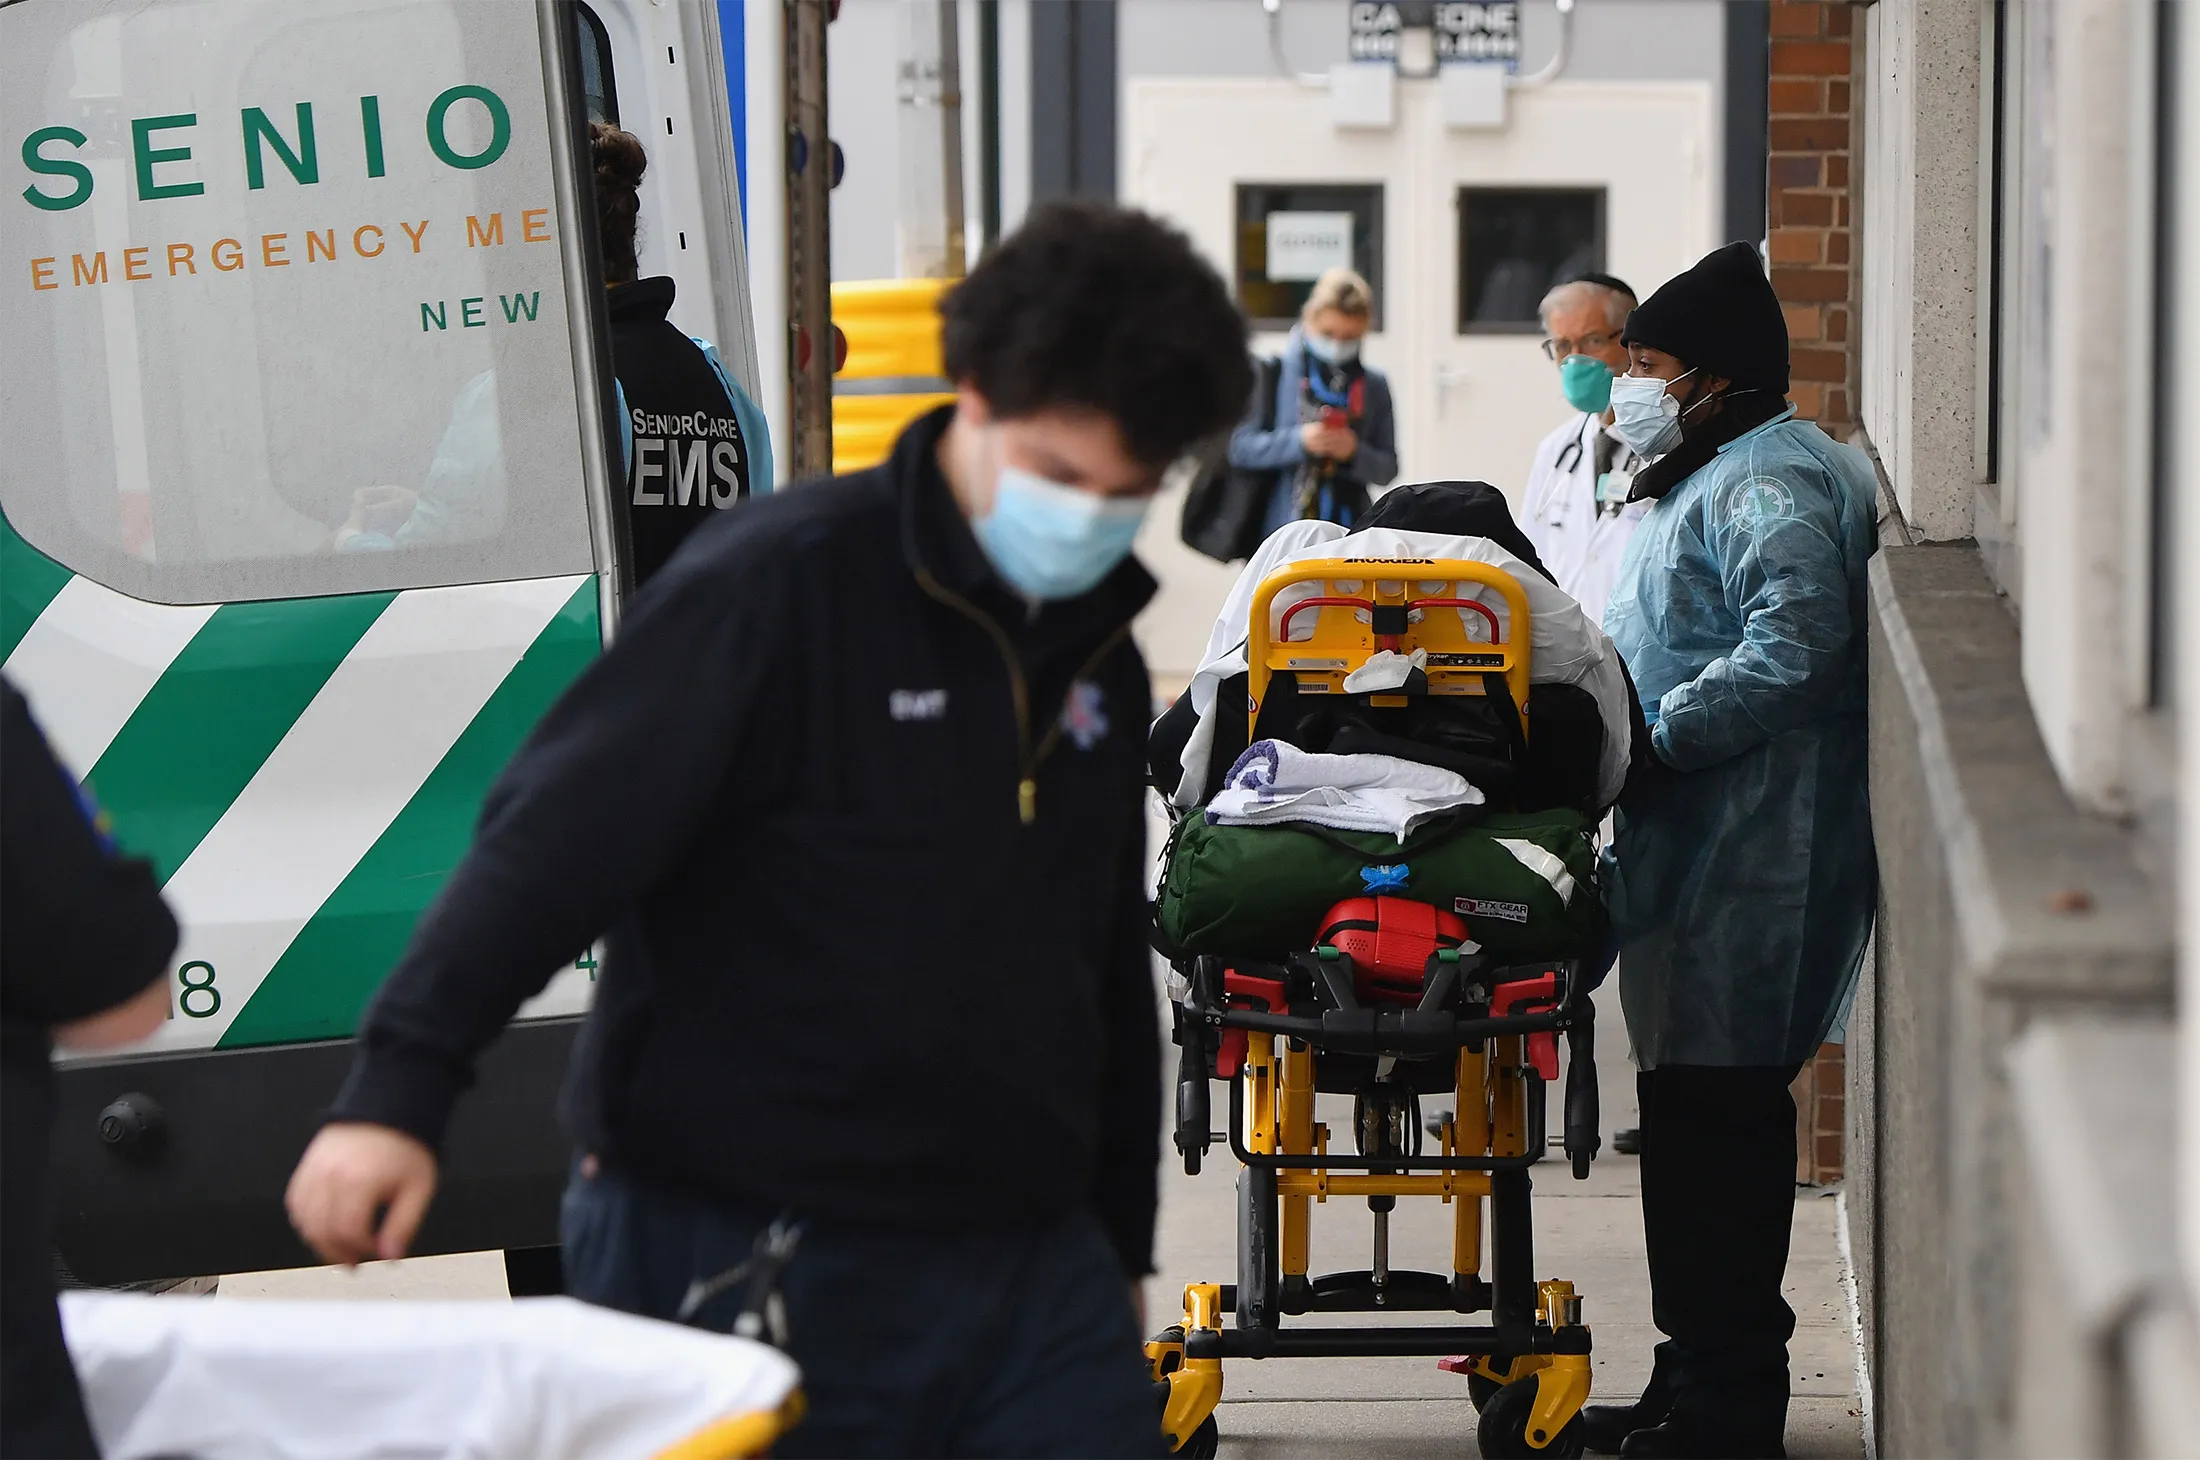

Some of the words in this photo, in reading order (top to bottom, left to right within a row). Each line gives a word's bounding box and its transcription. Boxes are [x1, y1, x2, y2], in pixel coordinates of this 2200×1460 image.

[21, 84, 512, 211] SENIO
[31, 220, 430, 291] EMERGENCY
[467, 208, 552, 249] ME
[420, 291, 541, 332] NEW
[633, 438, 739, 510] EMS
[1477, 901, 1496, 910] FTX
[1499, 903, 1528, 914] GEAR
